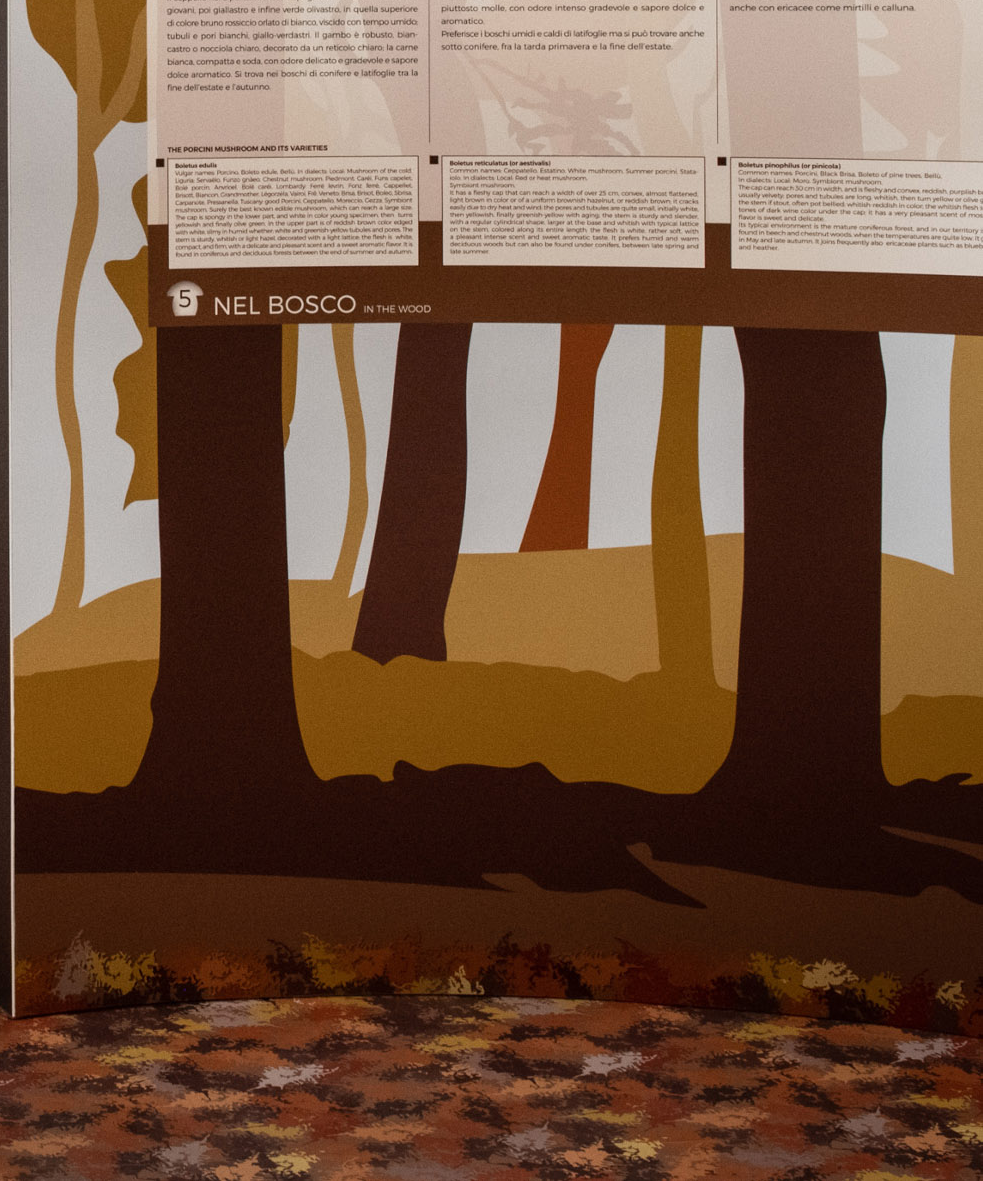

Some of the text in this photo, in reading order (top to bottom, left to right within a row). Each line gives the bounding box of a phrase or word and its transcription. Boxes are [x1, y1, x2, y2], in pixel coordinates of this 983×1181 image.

[730, 4, 757, 12] anche
[441, 30, 479, 38] Preferisce
[480, 30, 483, 38] i
[484, 30, 511, 38] boschi
[512, 30, 536, 38] umidi
[543, 30, 563, 38] caldi
[573, 29, 608, 39] latifoglie
[632, 29, 649, 39] può
[501, 43, 513, 51] fra
[514, 43, 522, 51] la
[524, 43, 546, 51] tarda
[548, 43, 591, 52] primavera
[179, 289, 191, 308] 5
[214, 294, 432, 316] NEL BOSCO IN THE WOOD
